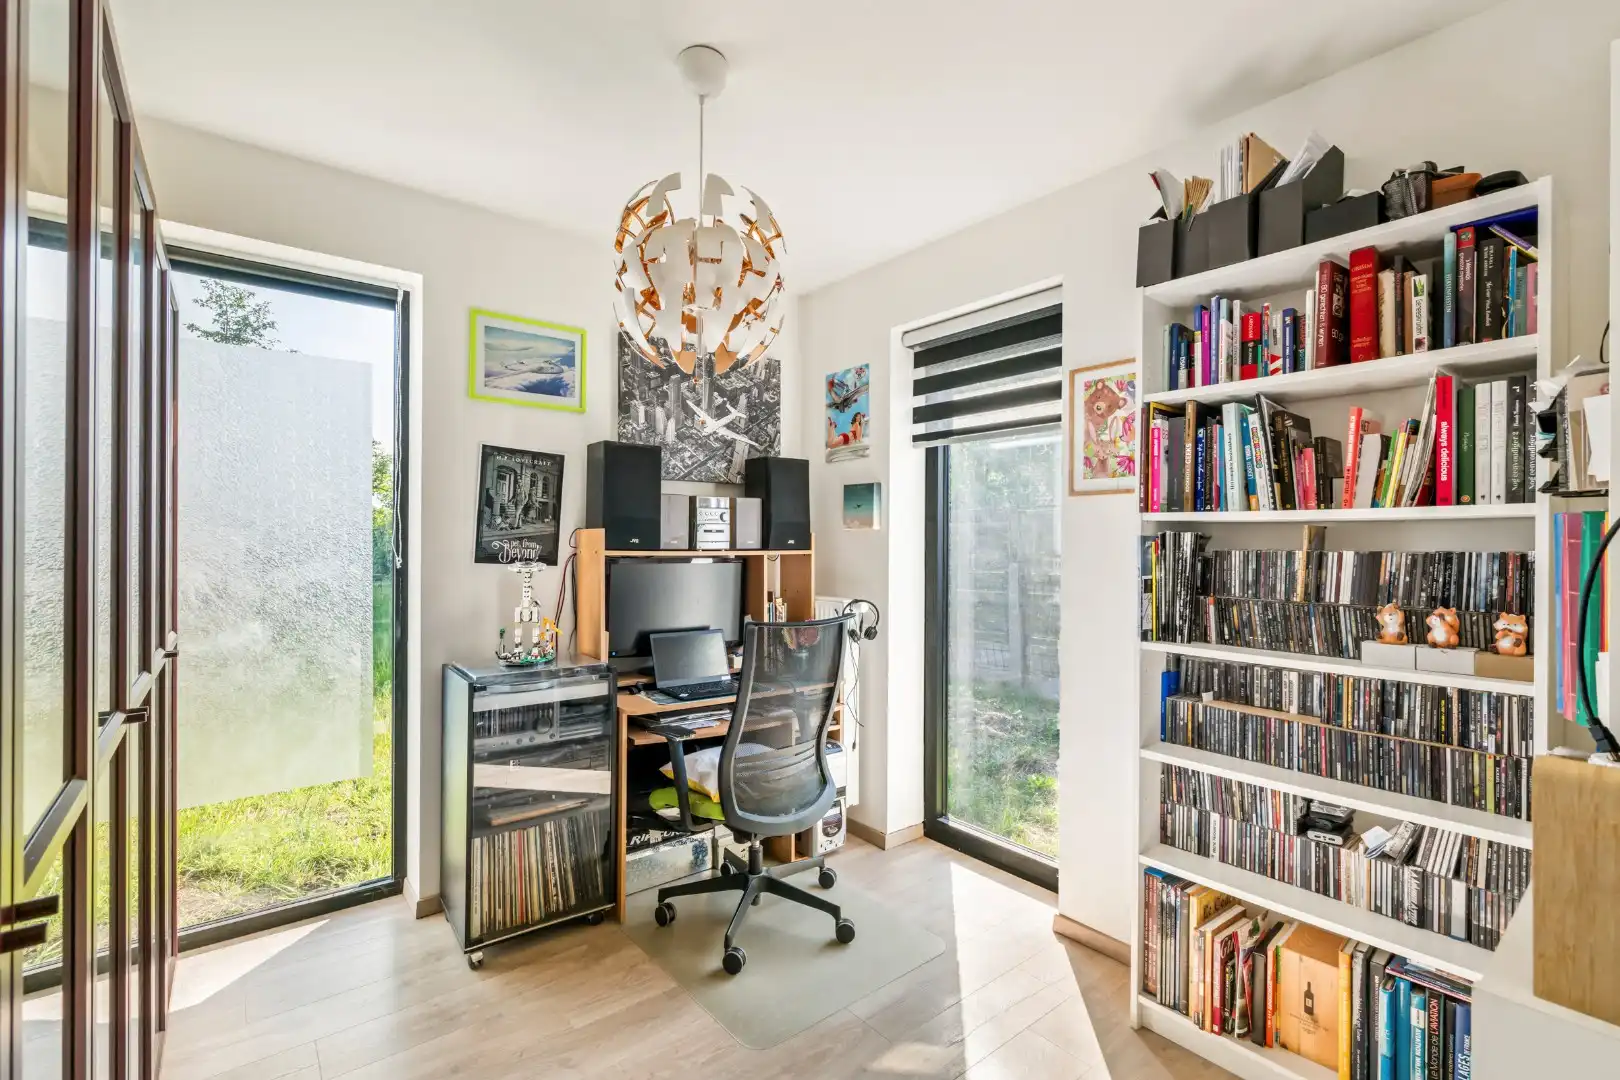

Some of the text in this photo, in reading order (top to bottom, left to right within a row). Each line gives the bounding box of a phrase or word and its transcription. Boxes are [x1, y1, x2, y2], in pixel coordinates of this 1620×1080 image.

[1184, 442, 1193, 465] GEEKS
[1438, 420, 1450, 482] always delicious
[1510, 435, 1520, 477] eenvoudiger
[1510, 478, 1519, 491] Nog
[1429, 998, 1439, 1080] Le Monde de L'AVIATION
